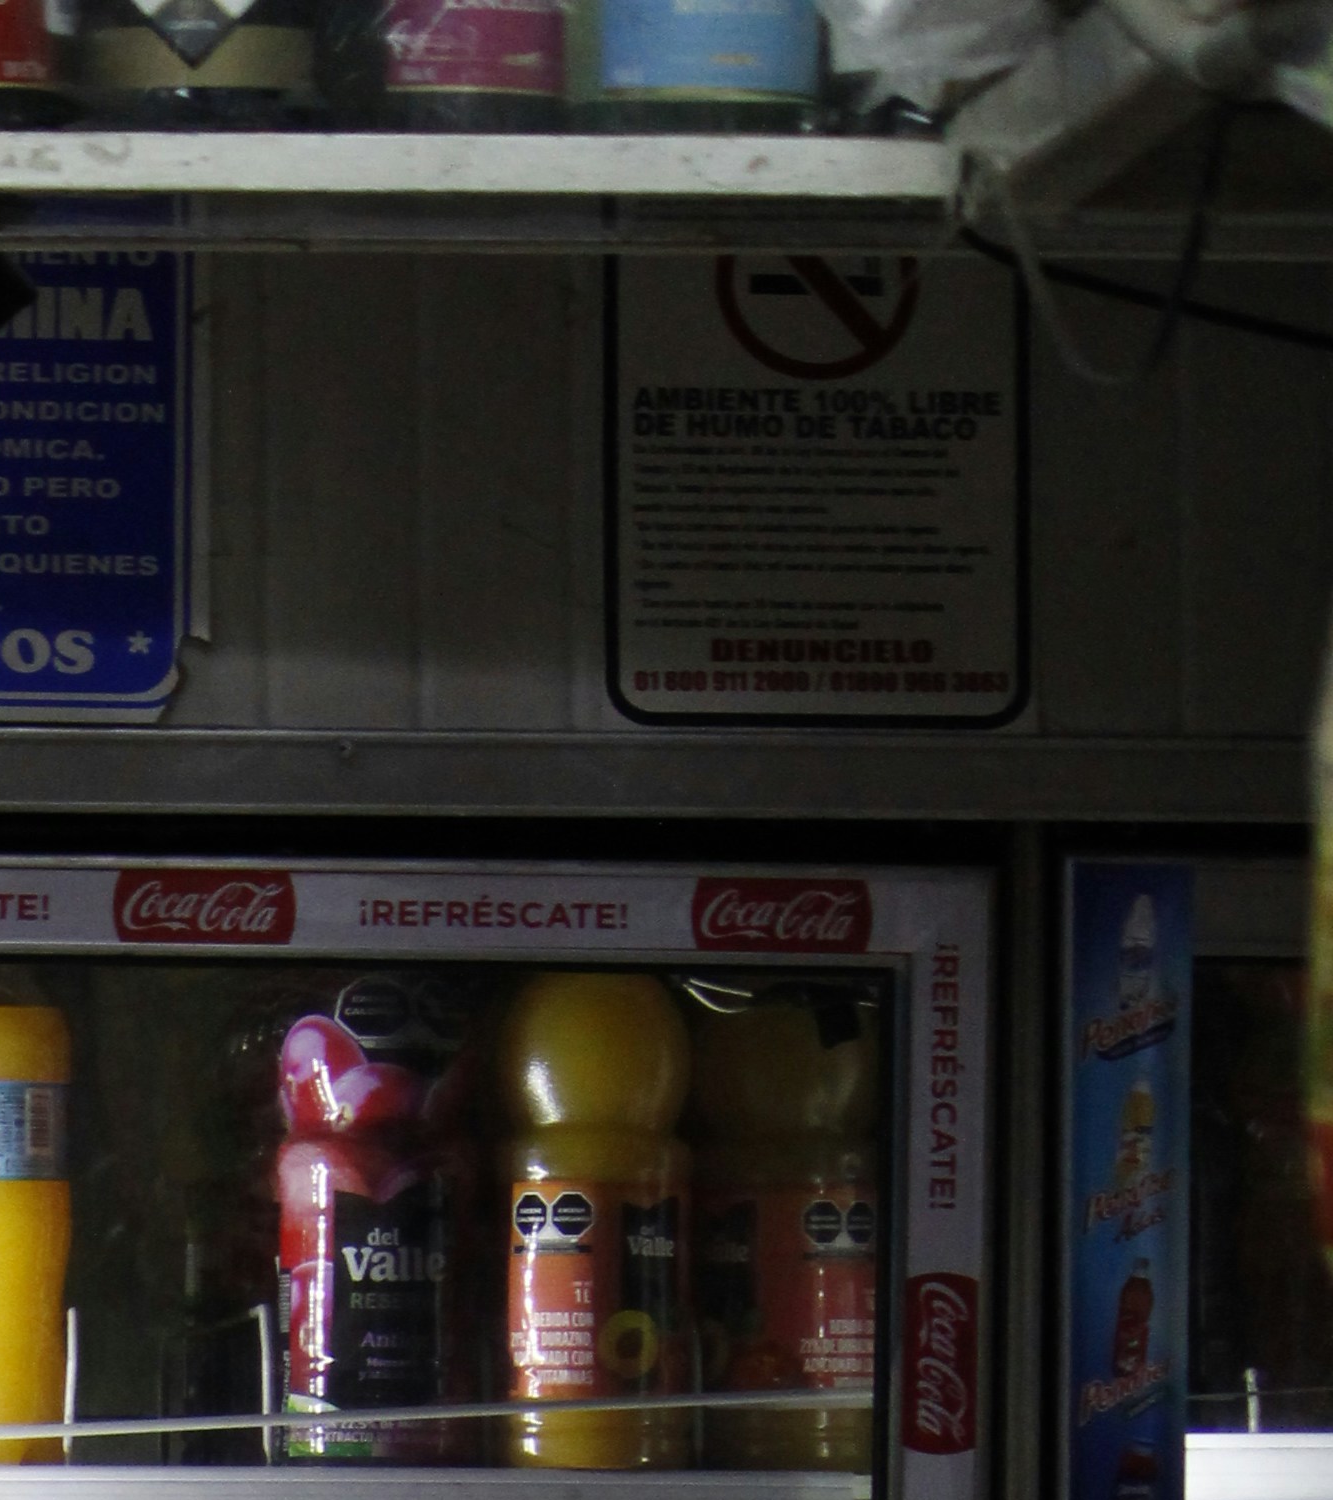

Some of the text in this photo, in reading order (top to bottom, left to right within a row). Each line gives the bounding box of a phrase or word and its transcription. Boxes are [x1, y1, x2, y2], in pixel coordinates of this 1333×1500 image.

[634, 388, 1001, 415] AMBIENTE 100% LIBRE
[635, 414, 977, 440] DE HUMO DE TABACO
[24, 477, 120, 498] PERO
[711, 640, 932, 661] DENUNCIELO
[122, 881, 277, 934] Coca-Cola
[359, 895, 628, 929] ¡REFRÉSCATE!
[931, 943, 961, 1210] ¡REFRÉSCATE!
[366, 1228, 399, 1246] del
[342, 1247, 445, 1281] Valle
[917, 1282, 967, 1441] Coca-Cola
